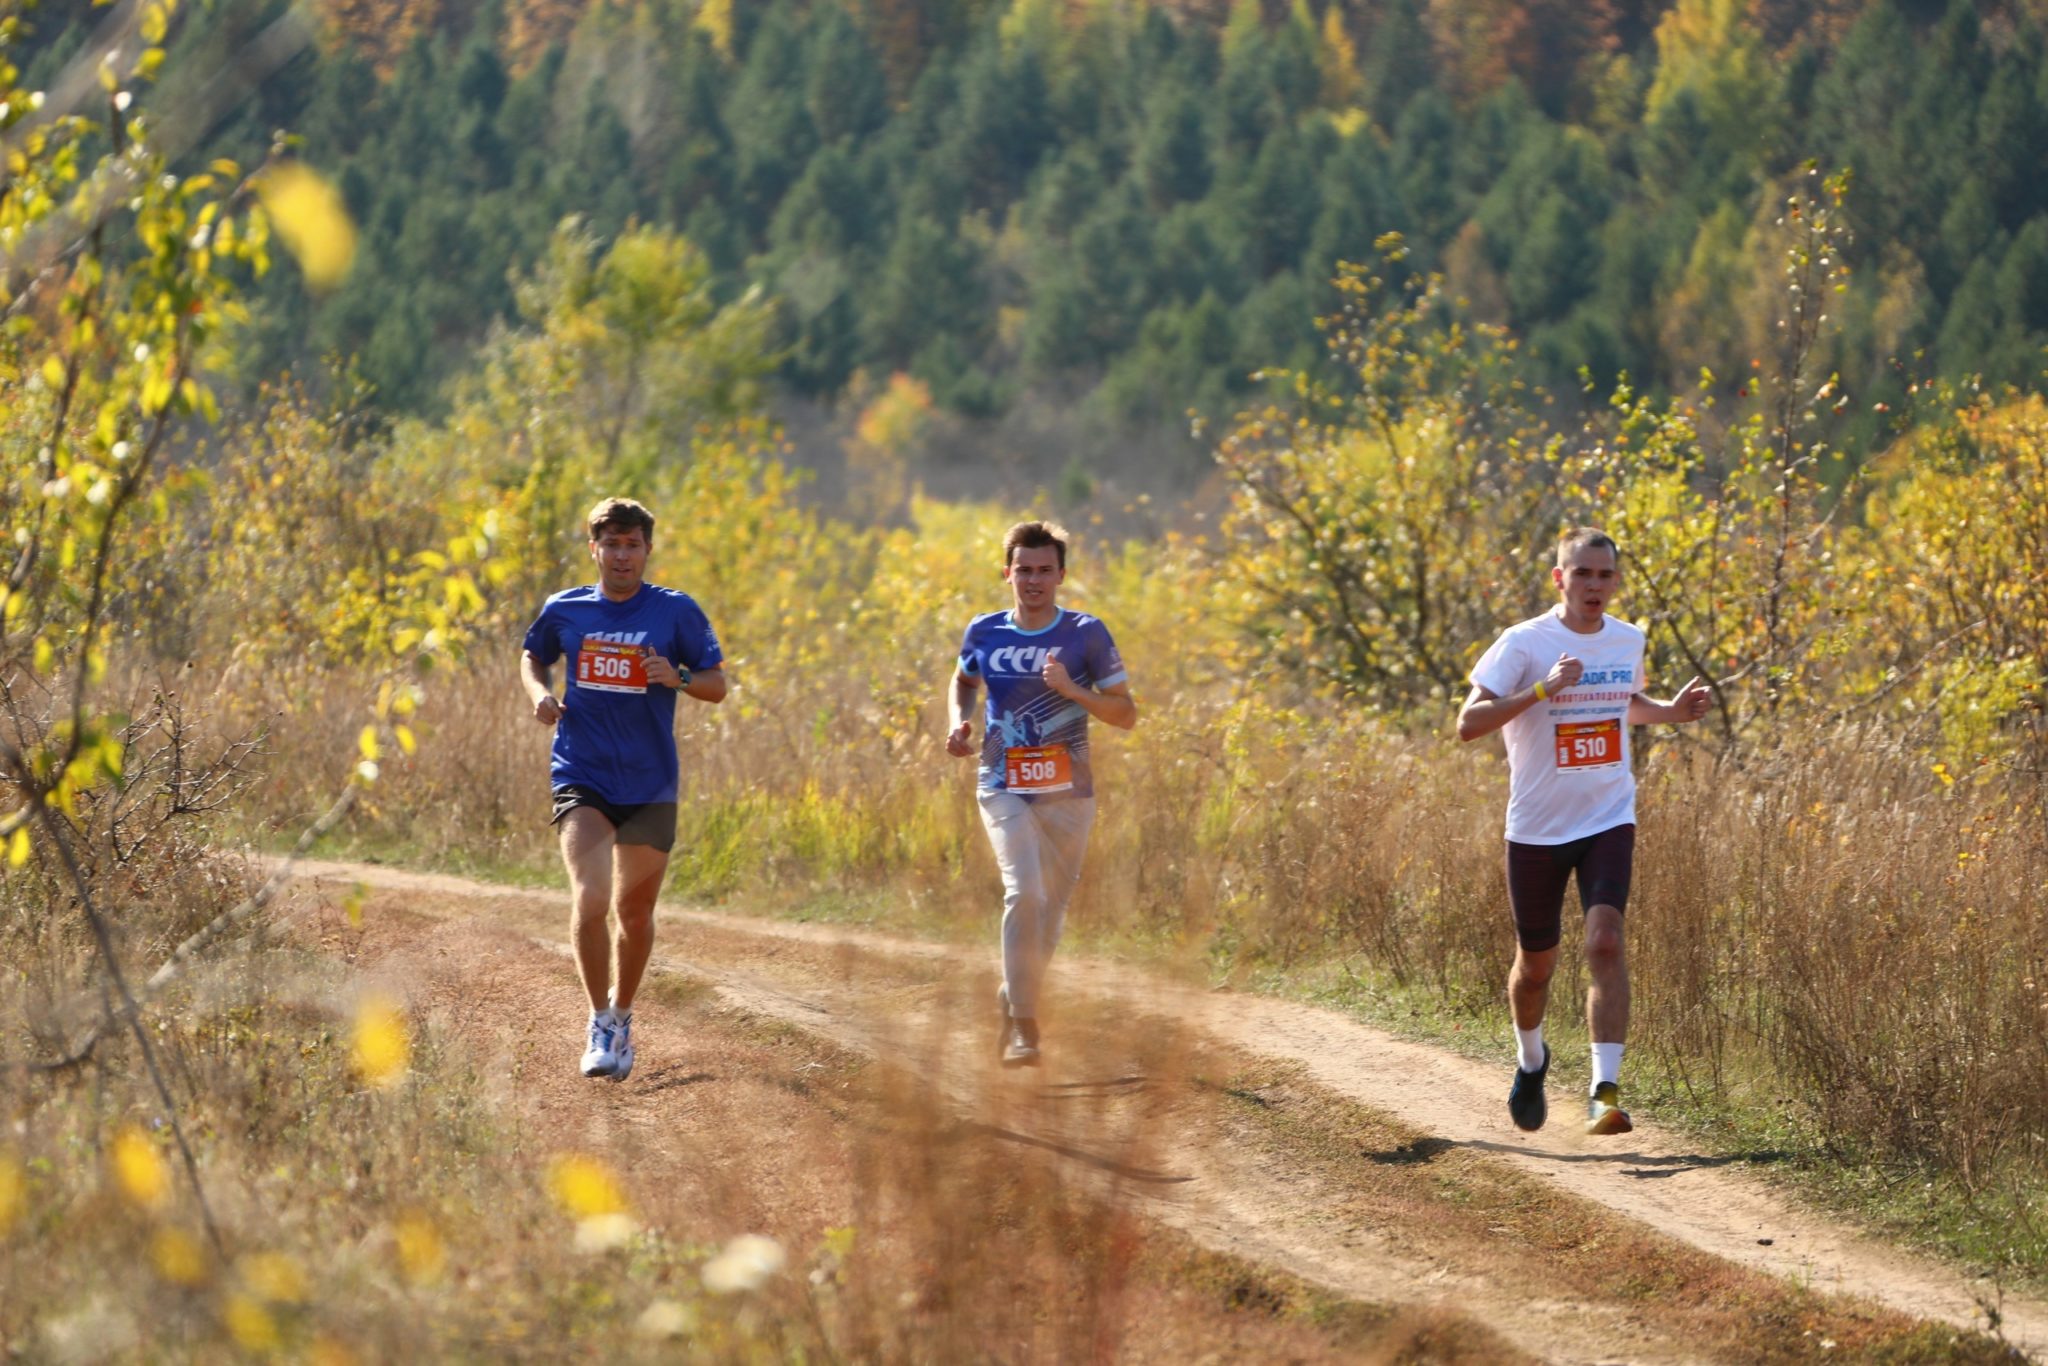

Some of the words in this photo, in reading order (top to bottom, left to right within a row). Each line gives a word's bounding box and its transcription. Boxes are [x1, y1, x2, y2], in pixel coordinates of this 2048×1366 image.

[594, 656, 630, 678] 506
[1577, 671, 1632, 685] ADR.PRO
[1575, 737, 1606, 758] 510
[1021, 761, 1055, 780] 508
